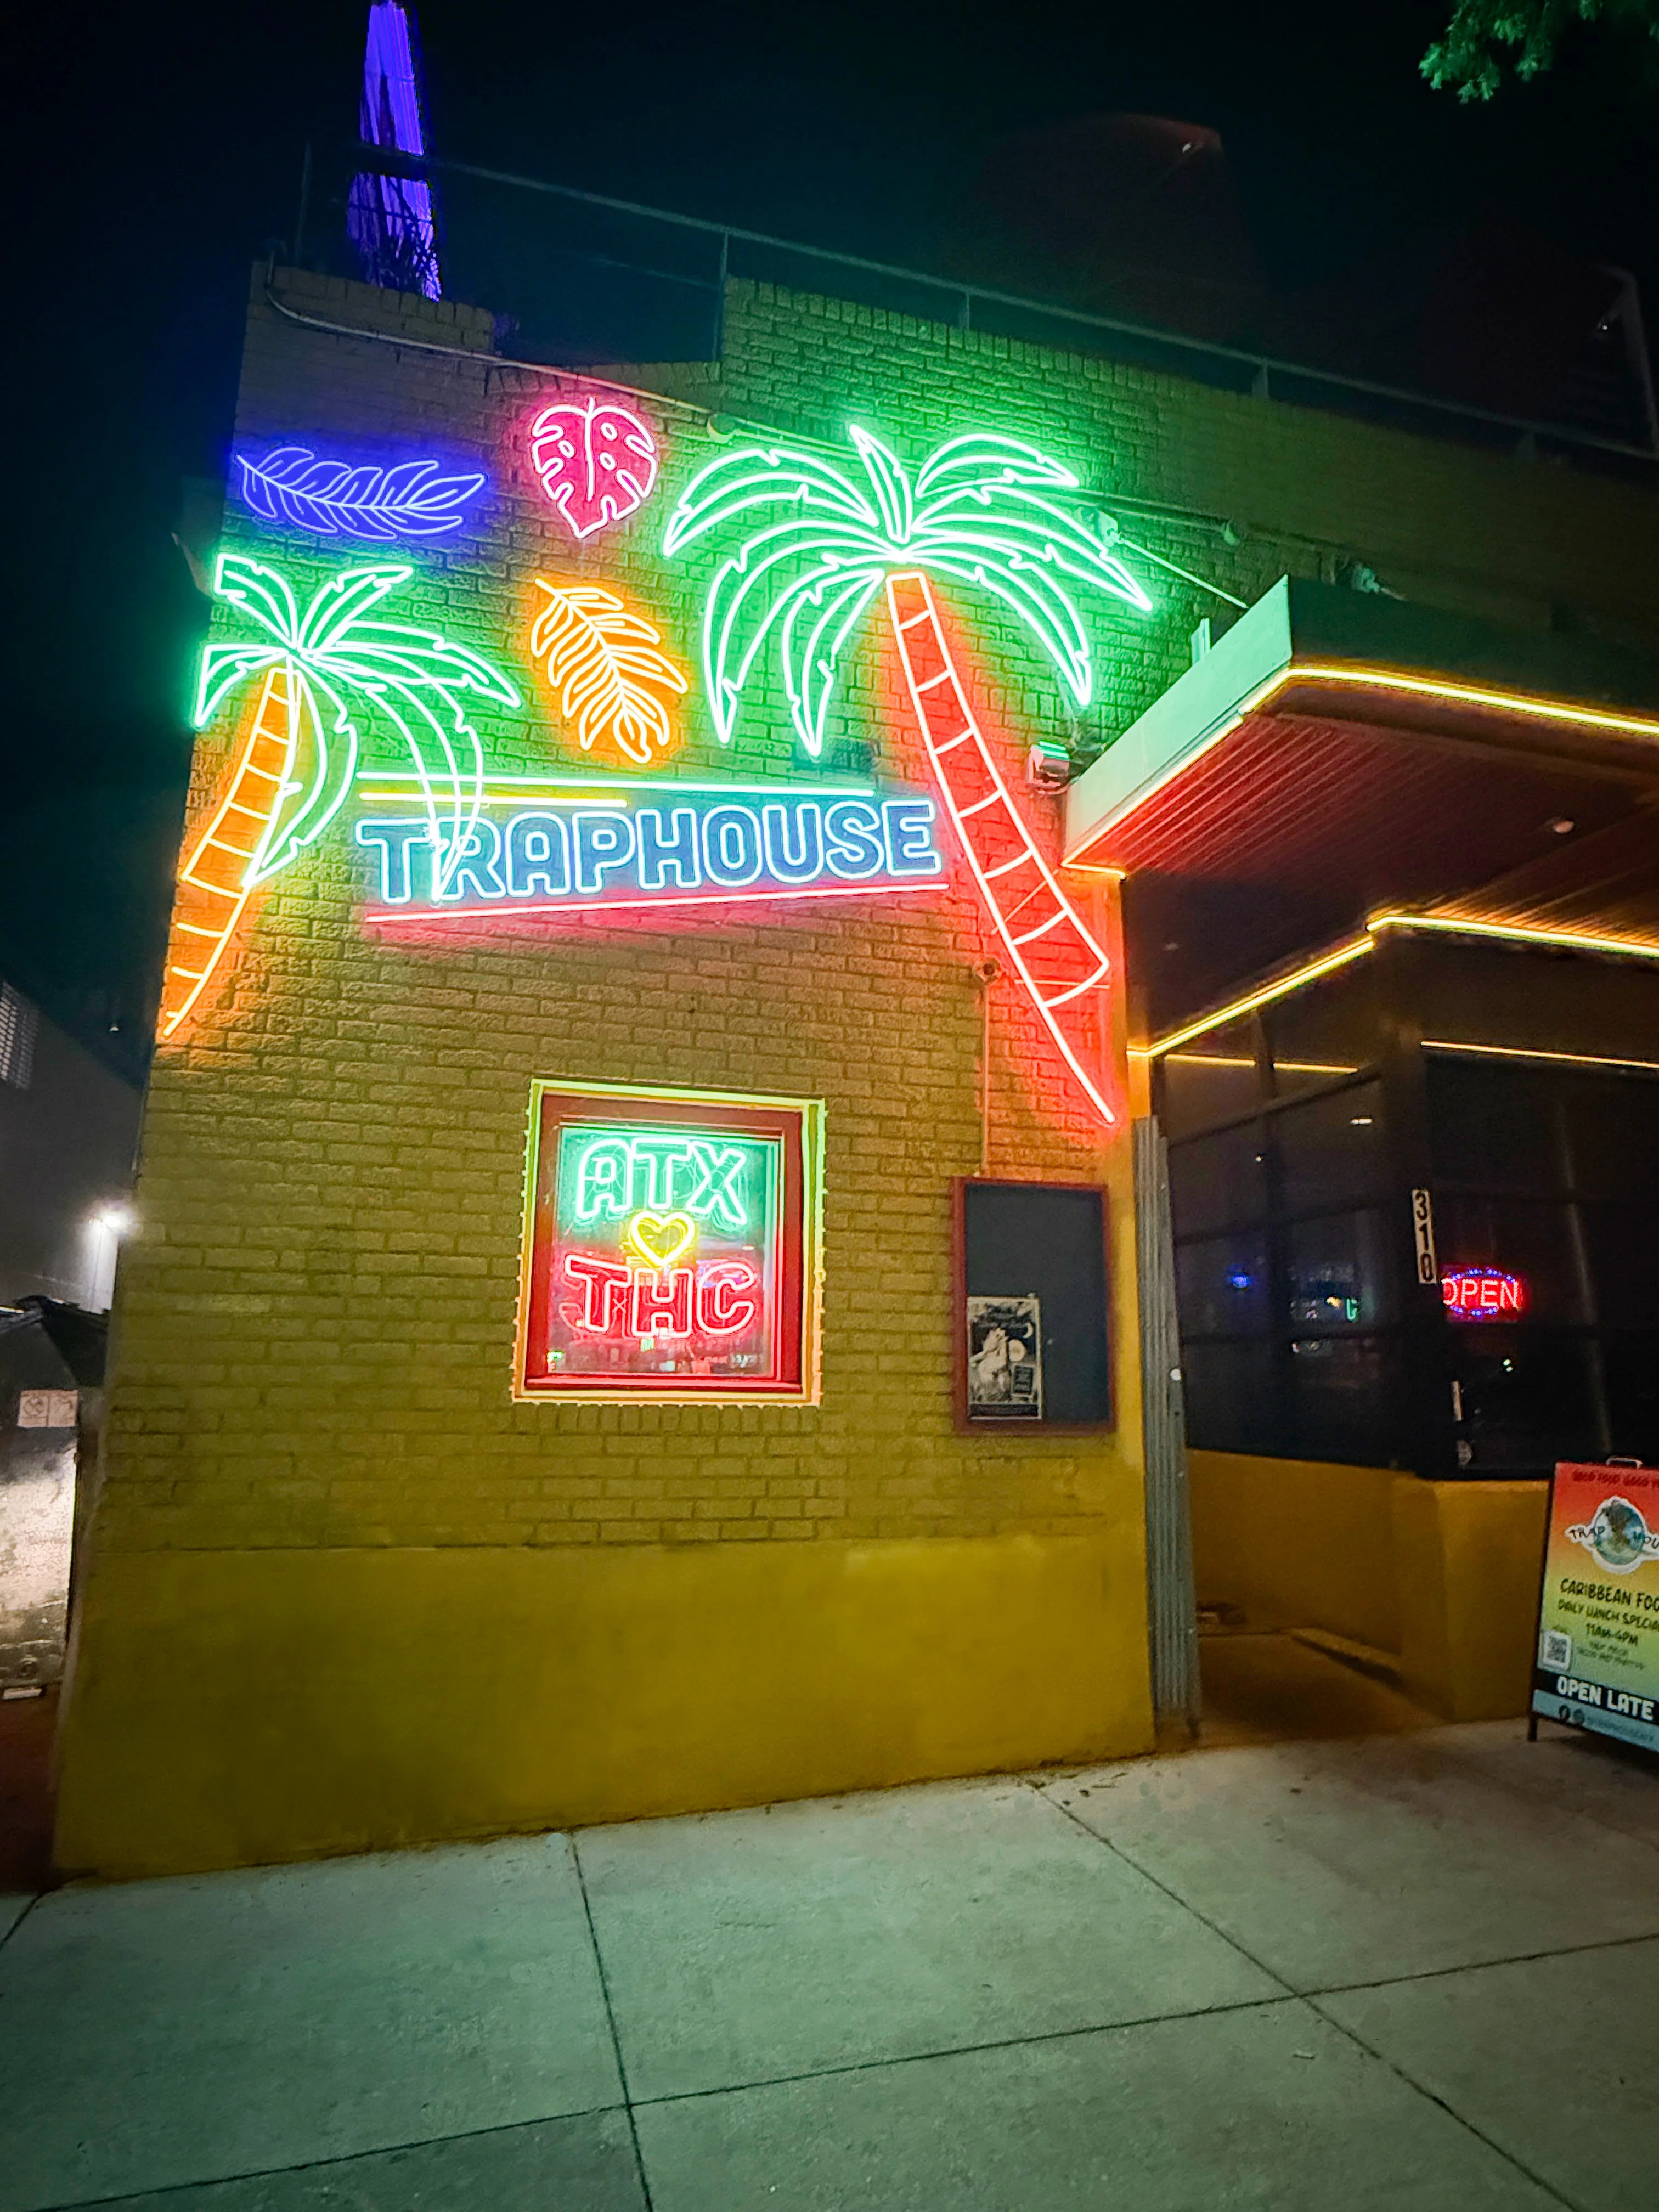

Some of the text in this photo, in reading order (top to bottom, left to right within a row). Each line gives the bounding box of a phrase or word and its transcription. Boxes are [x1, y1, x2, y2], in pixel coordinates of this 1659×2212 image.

[354, 798, 942, 906] TRAPHOUSE
[577, 1136, 748, 1226] ATX
[1415, 1192, 1433, 1282] 310
[563, 1252, 757, 1339] THC
[1441, 1277, 1519, 1310] OPEN
[1560, 1578, 1632, 1606] CARIBBEAN
[1557, 1675, 1655, 1721] OPEN LATE
